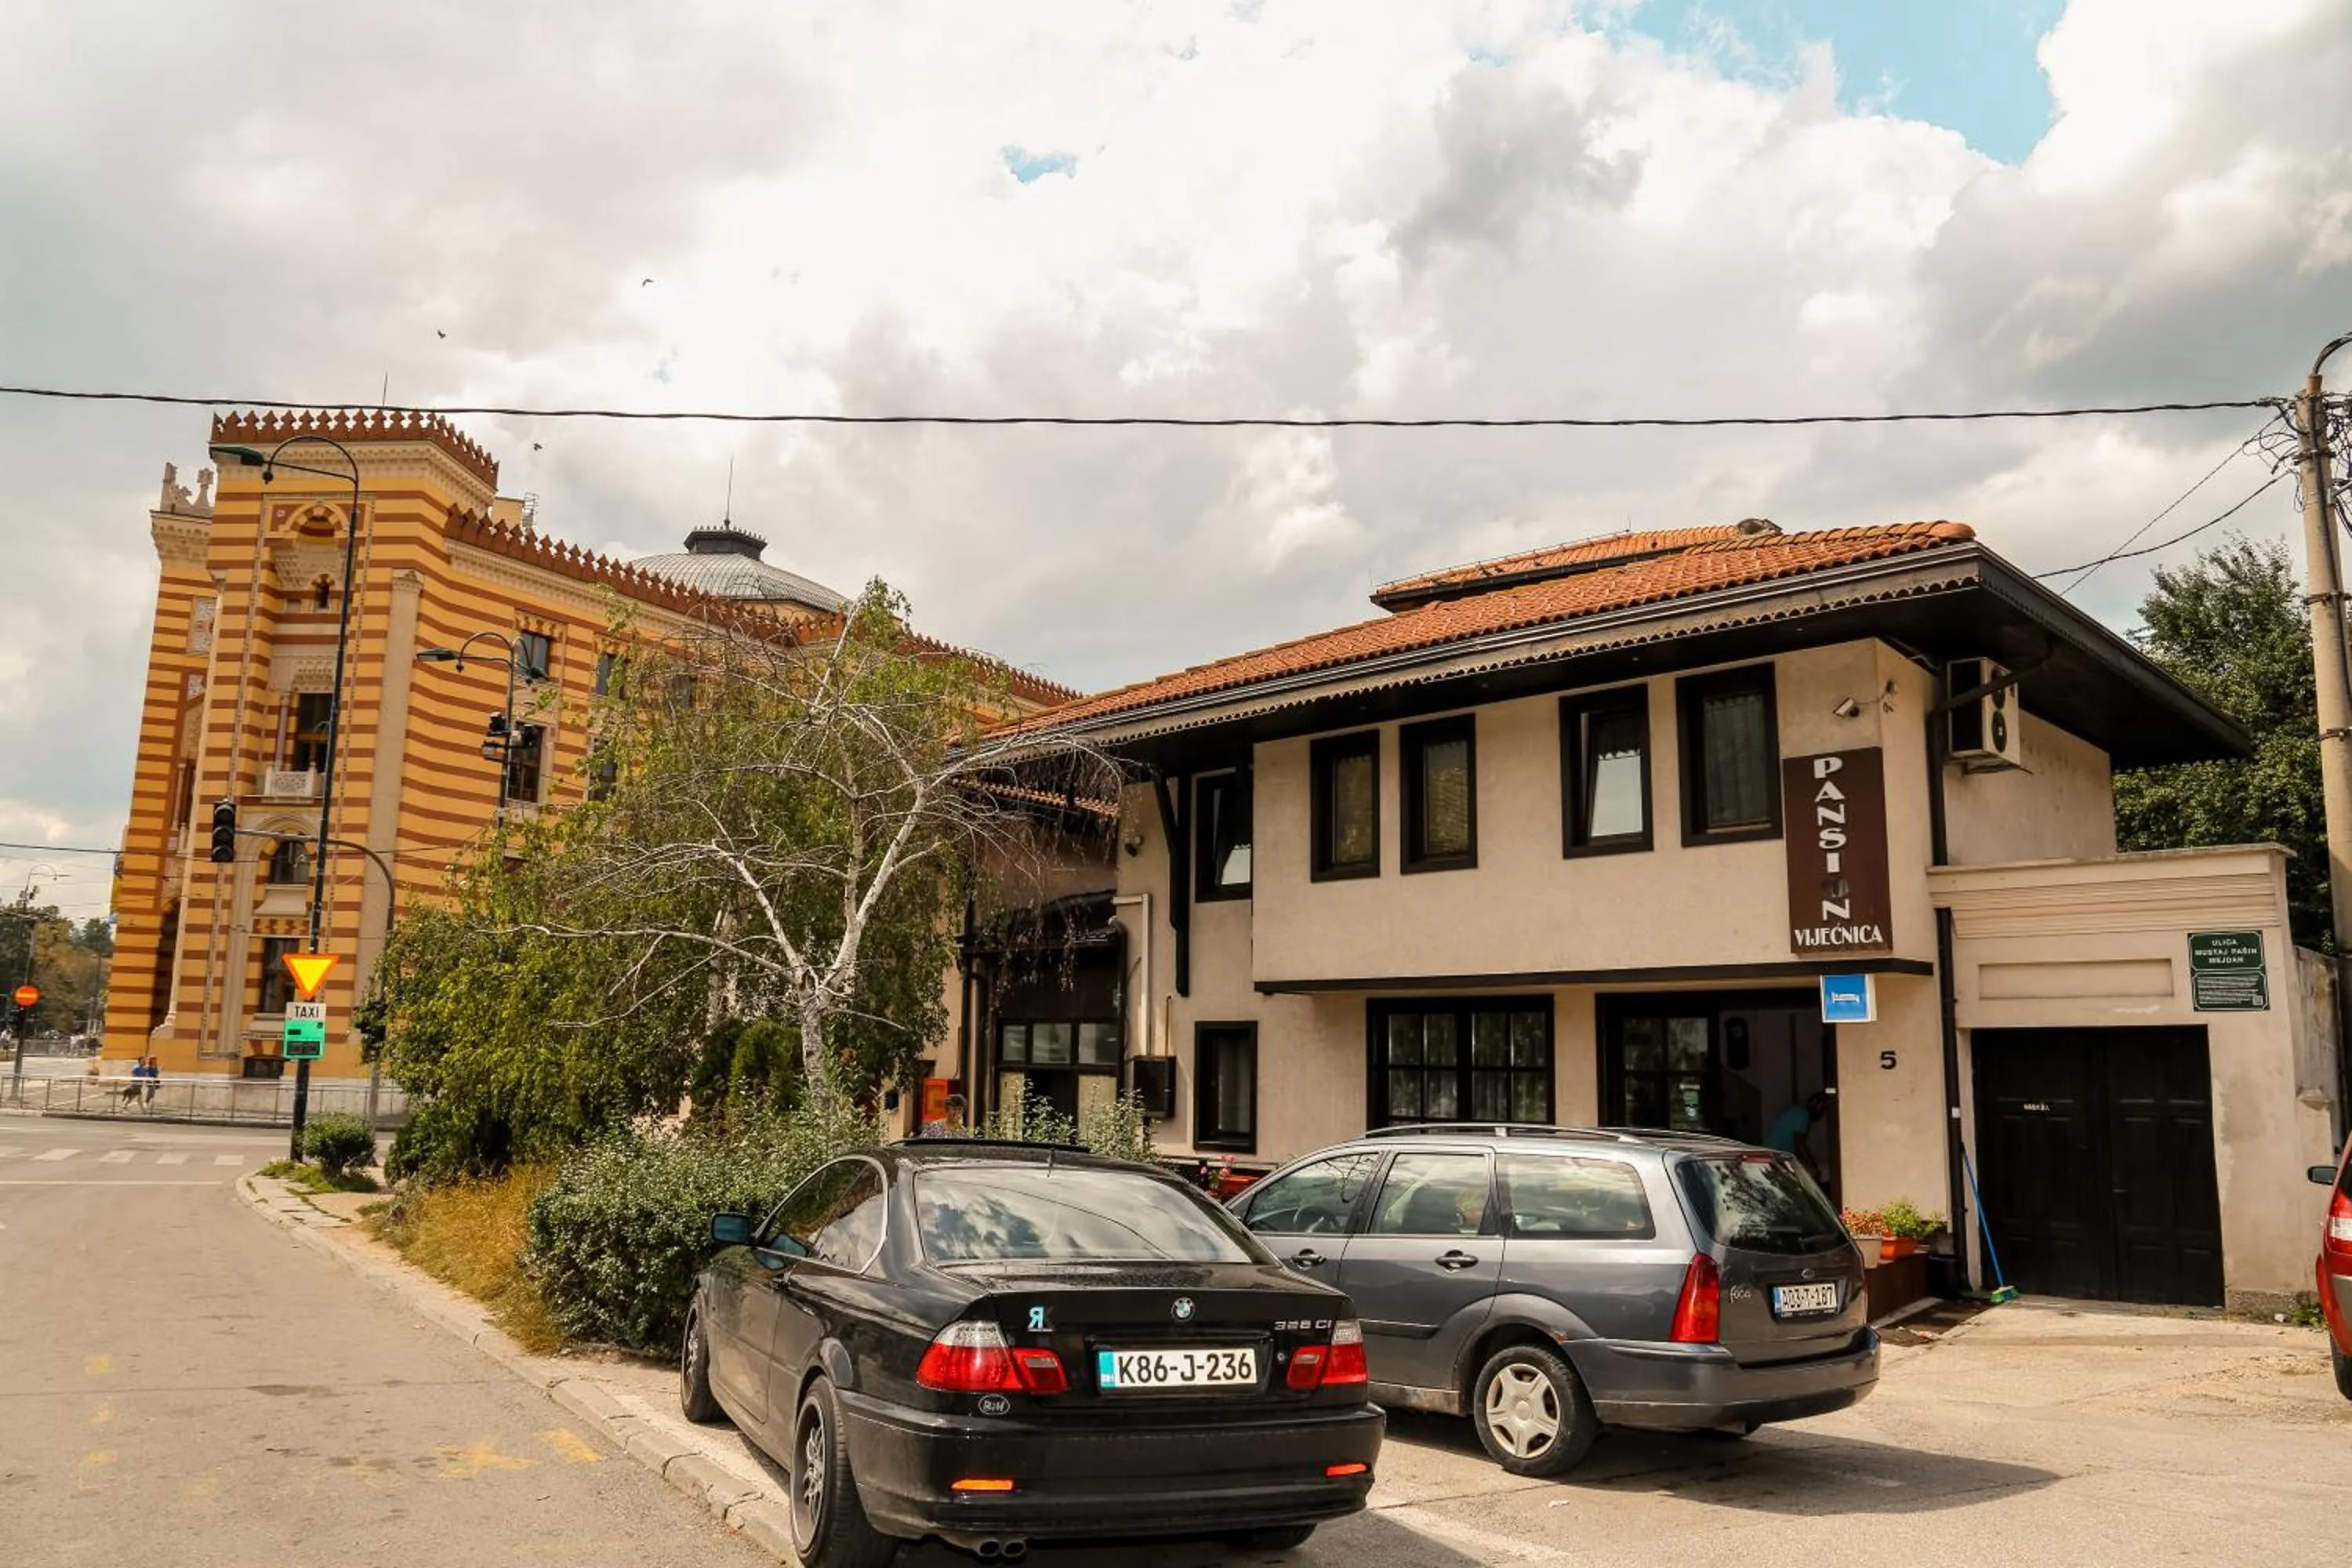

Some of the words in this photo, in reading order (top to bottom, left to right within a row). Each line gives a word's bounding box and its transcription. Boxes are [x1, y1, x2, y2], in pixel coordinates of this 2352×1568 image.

[295, 1006, 319, 1018] TAXI
[1881, 1051, 1896, 1070] 5
[1118, 1353, 1252, 1384] K86-J-236
